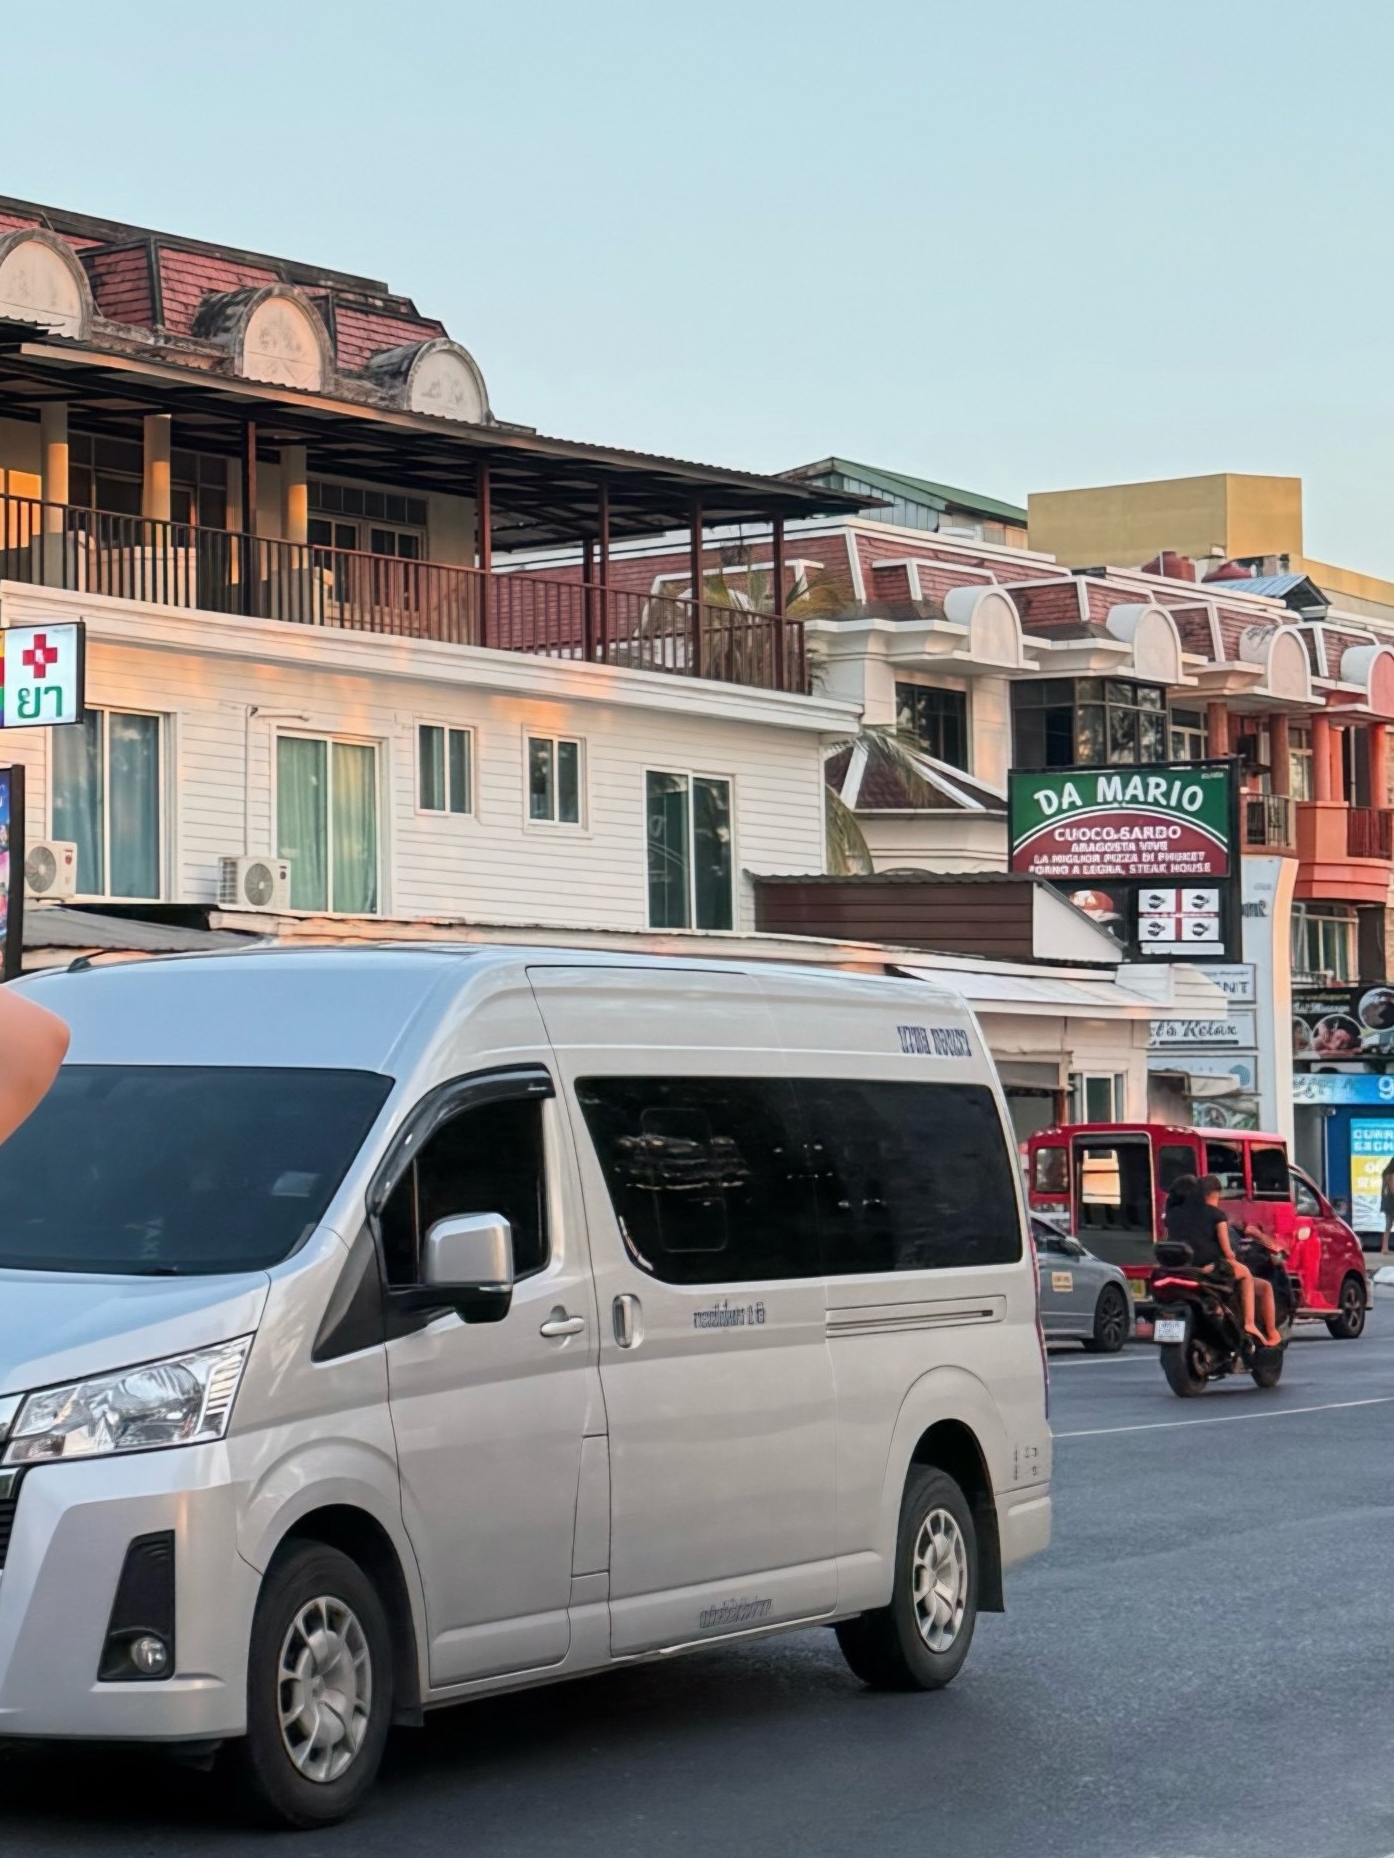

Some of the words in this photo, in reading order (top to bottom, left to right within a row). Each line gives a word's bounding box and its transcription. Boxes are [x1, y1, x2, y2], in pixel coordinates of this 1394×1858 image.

[17, 685, 63, 719] ยา
[1033, 781, 1083, 815] DA
[1097, 774, 1204, 812] MARIO
